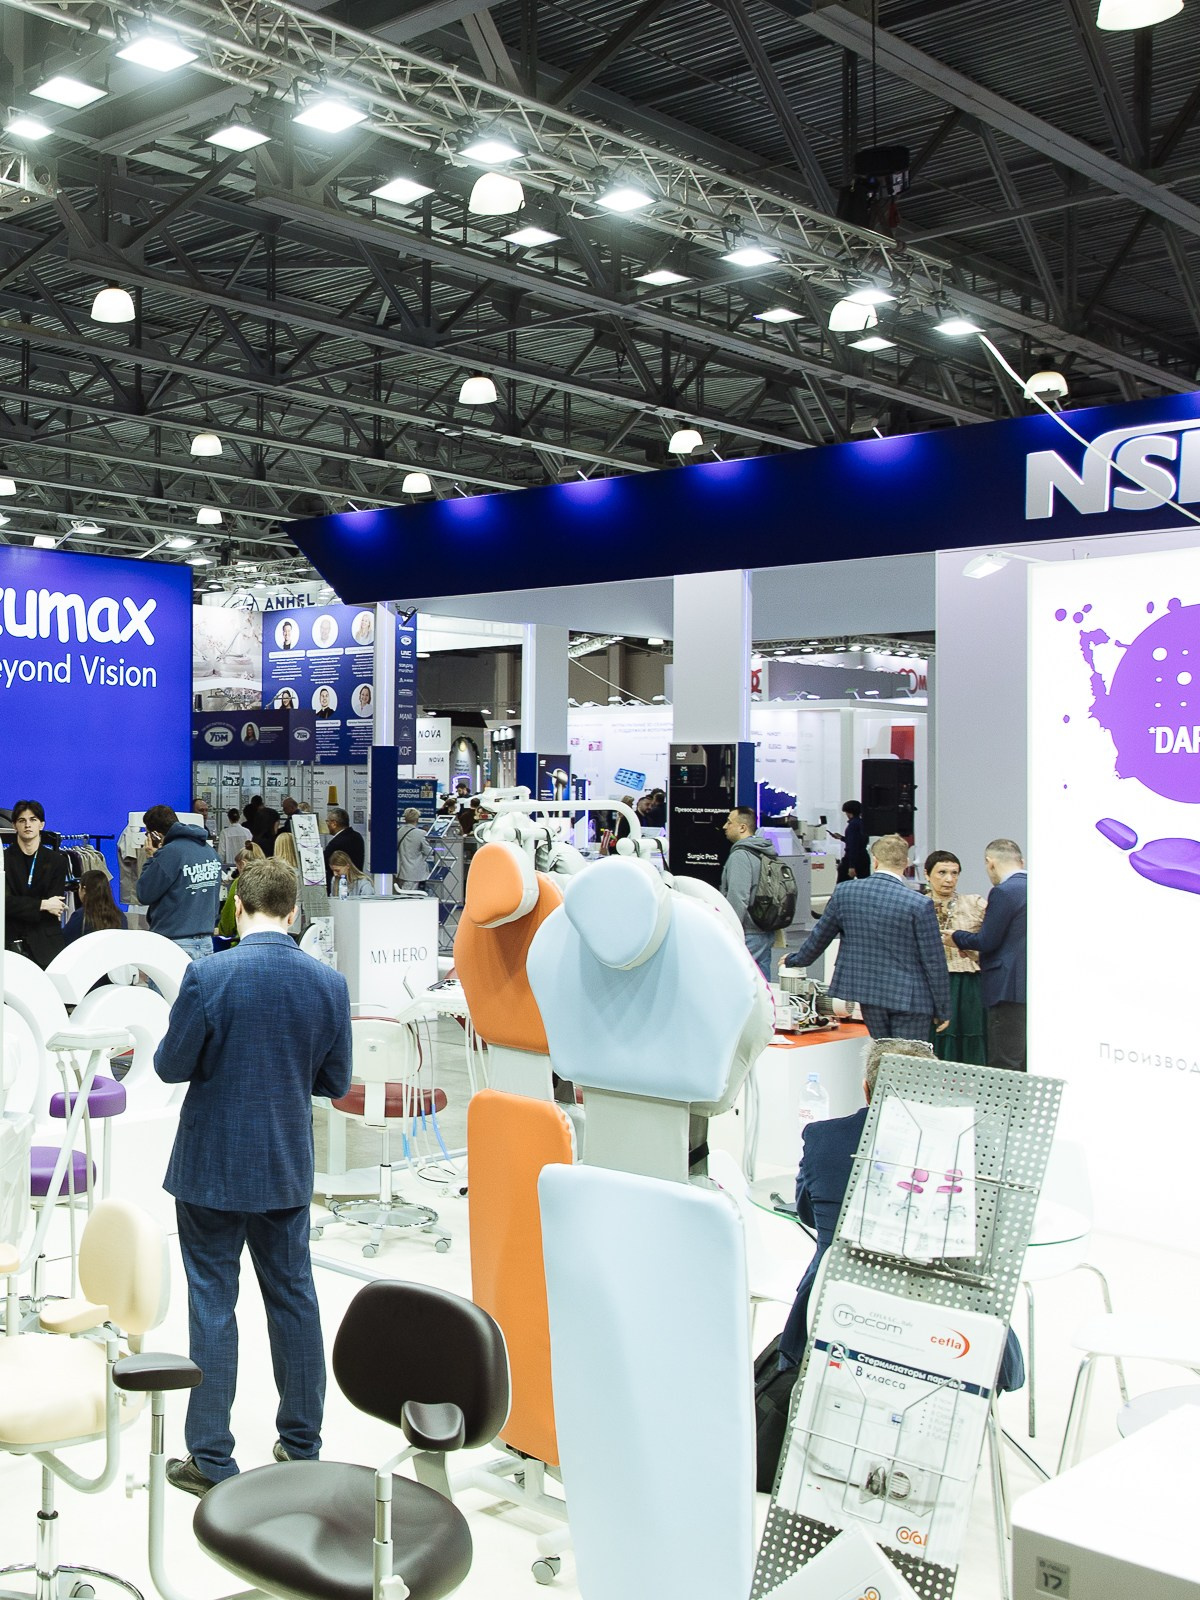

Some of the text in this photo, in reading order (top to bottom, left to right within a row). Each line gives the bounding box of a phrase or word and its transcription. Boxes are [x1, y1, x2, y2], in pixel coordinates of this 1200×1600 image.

[264, 593, 316, 611] ANHEL
[79, 654, 157, 688] Vision
[418, 729, 441, 738] NOVA
[687, 853, 705, 861] Surgic
[371, 946, 427, 964] MY HERO
[837, 1309, 903, 1335] mocom
[930, 1334, 963, 1351] cefla
[857, 1353, 927, 1381] Стерилизаторы
[866, 1373, 906, 1390] класса
